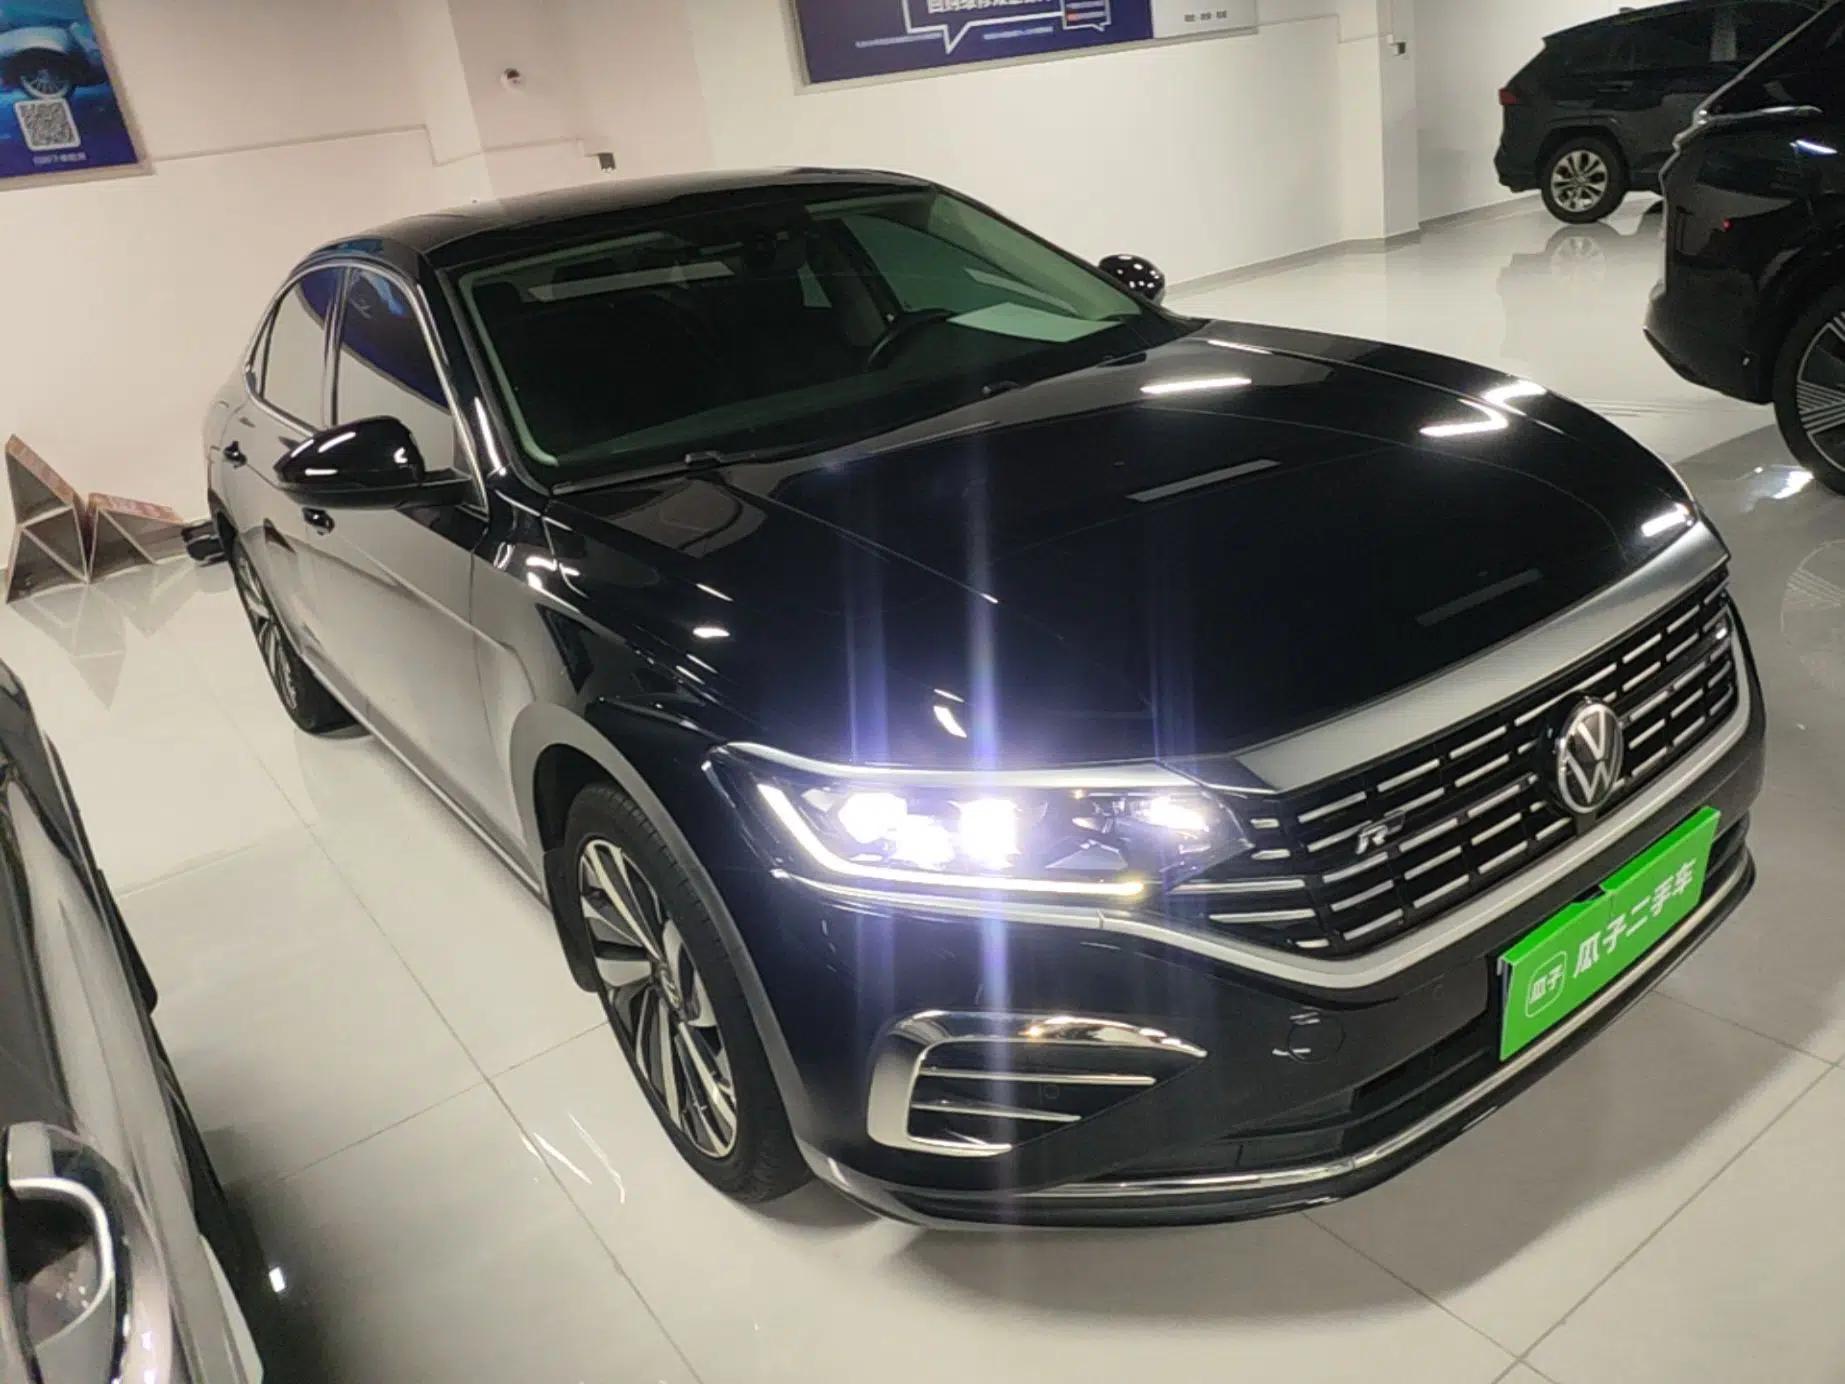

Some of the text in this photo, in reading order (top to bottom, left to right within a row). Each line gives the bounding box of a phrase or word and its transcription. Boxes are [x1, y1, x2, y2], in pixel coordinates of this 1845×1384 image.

[1573, 858, 1696, 978] 瓜子二手车
[1528, 963, 1564, 1004] 瓜子
